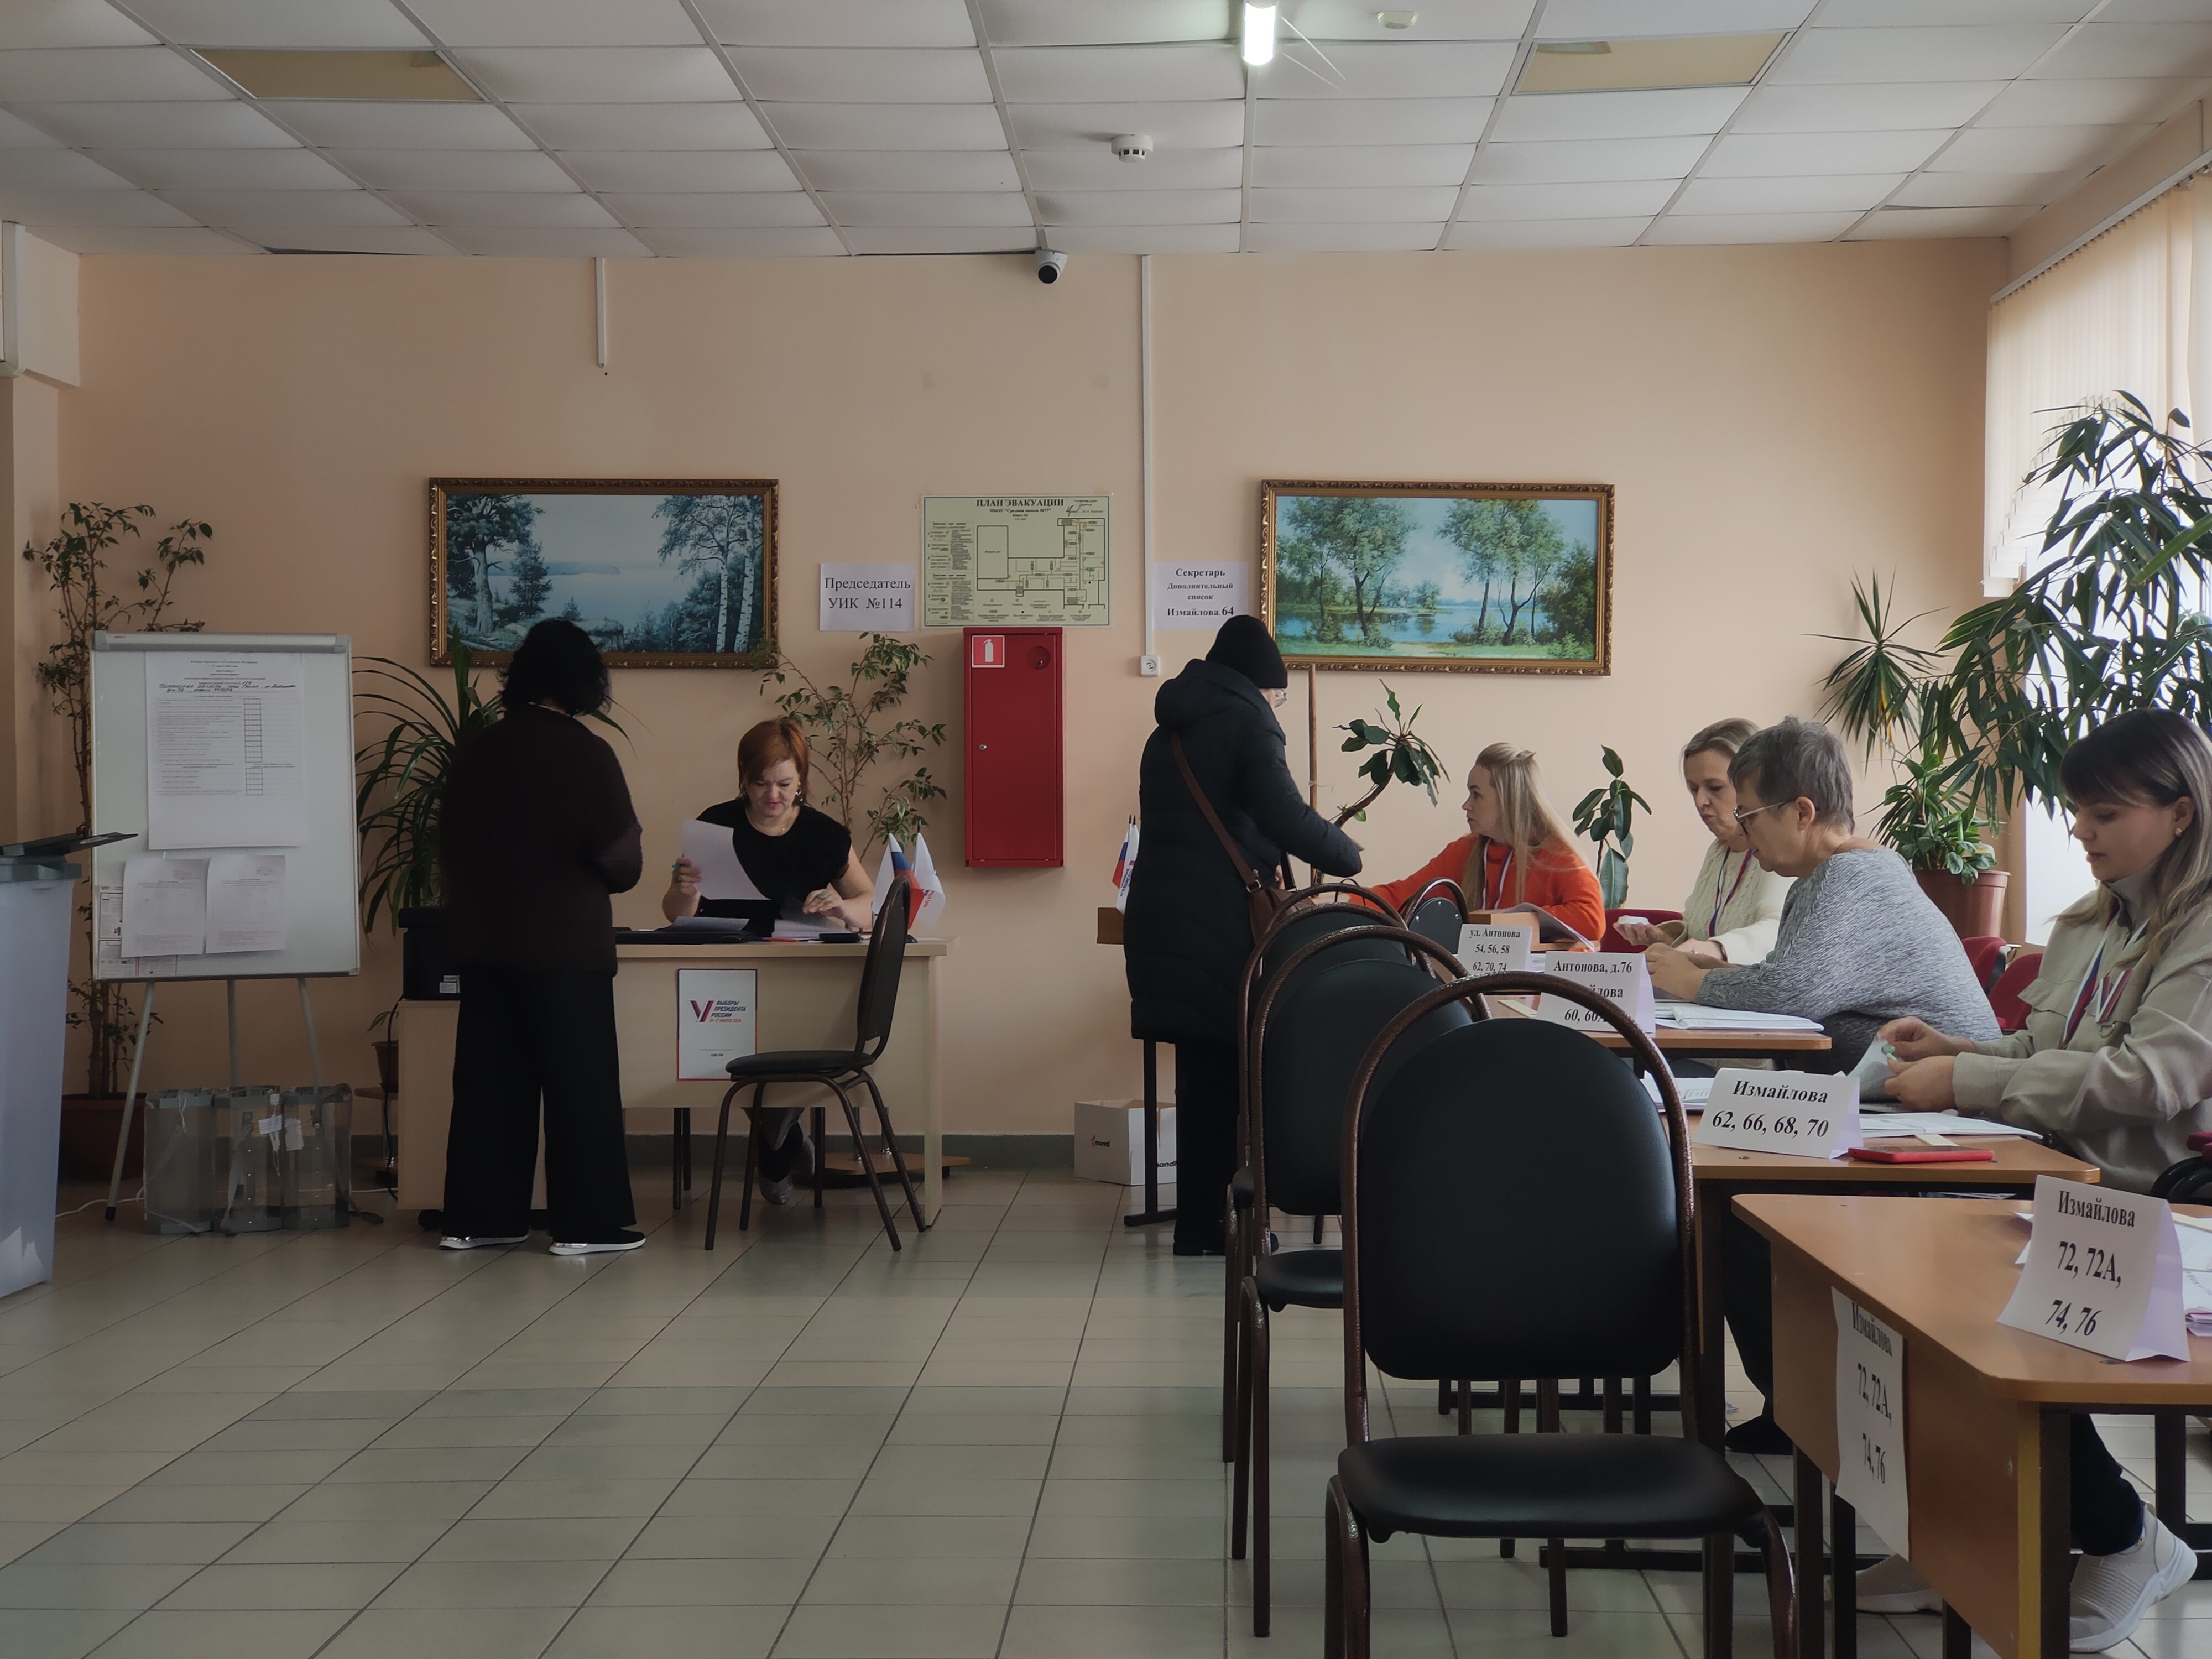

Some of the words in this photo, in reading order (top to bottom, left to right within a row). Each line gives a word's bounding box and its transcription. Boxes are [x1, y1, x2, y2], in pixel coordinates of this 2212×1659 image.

[1005, 499, 1064, 508] ЭВАКУАЦИИ
[1176, 568, 1225, 578] Секретарь
[825, 577, 911, 592] Председатель
[1167, 582, 1233, 591] Дополнительный
[828, 597, 859, 609] УИК
[866, 597, 902, 609] №114
[1222, 606, 1234, 616] 64
[1469, 930, 1480, 939] ул.
[1482, 928, 1521, 938] Антонова
[1475, 943, 1485, 954] 54,
[1487, 944, 1499, 955] 56,
[1500, 945, 1510, 954] 58
[1473, 961, 1483, 971] 62,
[1498, 962, 1507, 972] 74
[1553, 960, 1608, 975] Антонова,
[1610, 961, 1632, 973] д.76
[1564, 1008, 1580, 1024] 60,
[1732, 1080, 1828, 1104] Измайлова
[1712, 1110, 1736, 1133] 62,
[1743, 1113, 1767, 1135] 66,
[1773, 1115, 1799, 1139] 68,
[1806, 1119, 1829, 1138] 70
[2057, 1190, 2136, 1228] Измайлова
[2057, 1240, 2079, 1279] 72,
[2085, 1247, 2122, 1290] 72А,
[2045, 1299, 2073, 1335] 74,
[2074, 1307, 2103, 1337] 76
[1852, 1301, 1893, 1358] Измайлова
[1857, 1362, 1869, 1410] 72,
[1871, 1373, 1892, 1428] 72А,
[1862, 1432, 1875, 1481] 74,
[1875, 1444, 1886, 1485] 76
